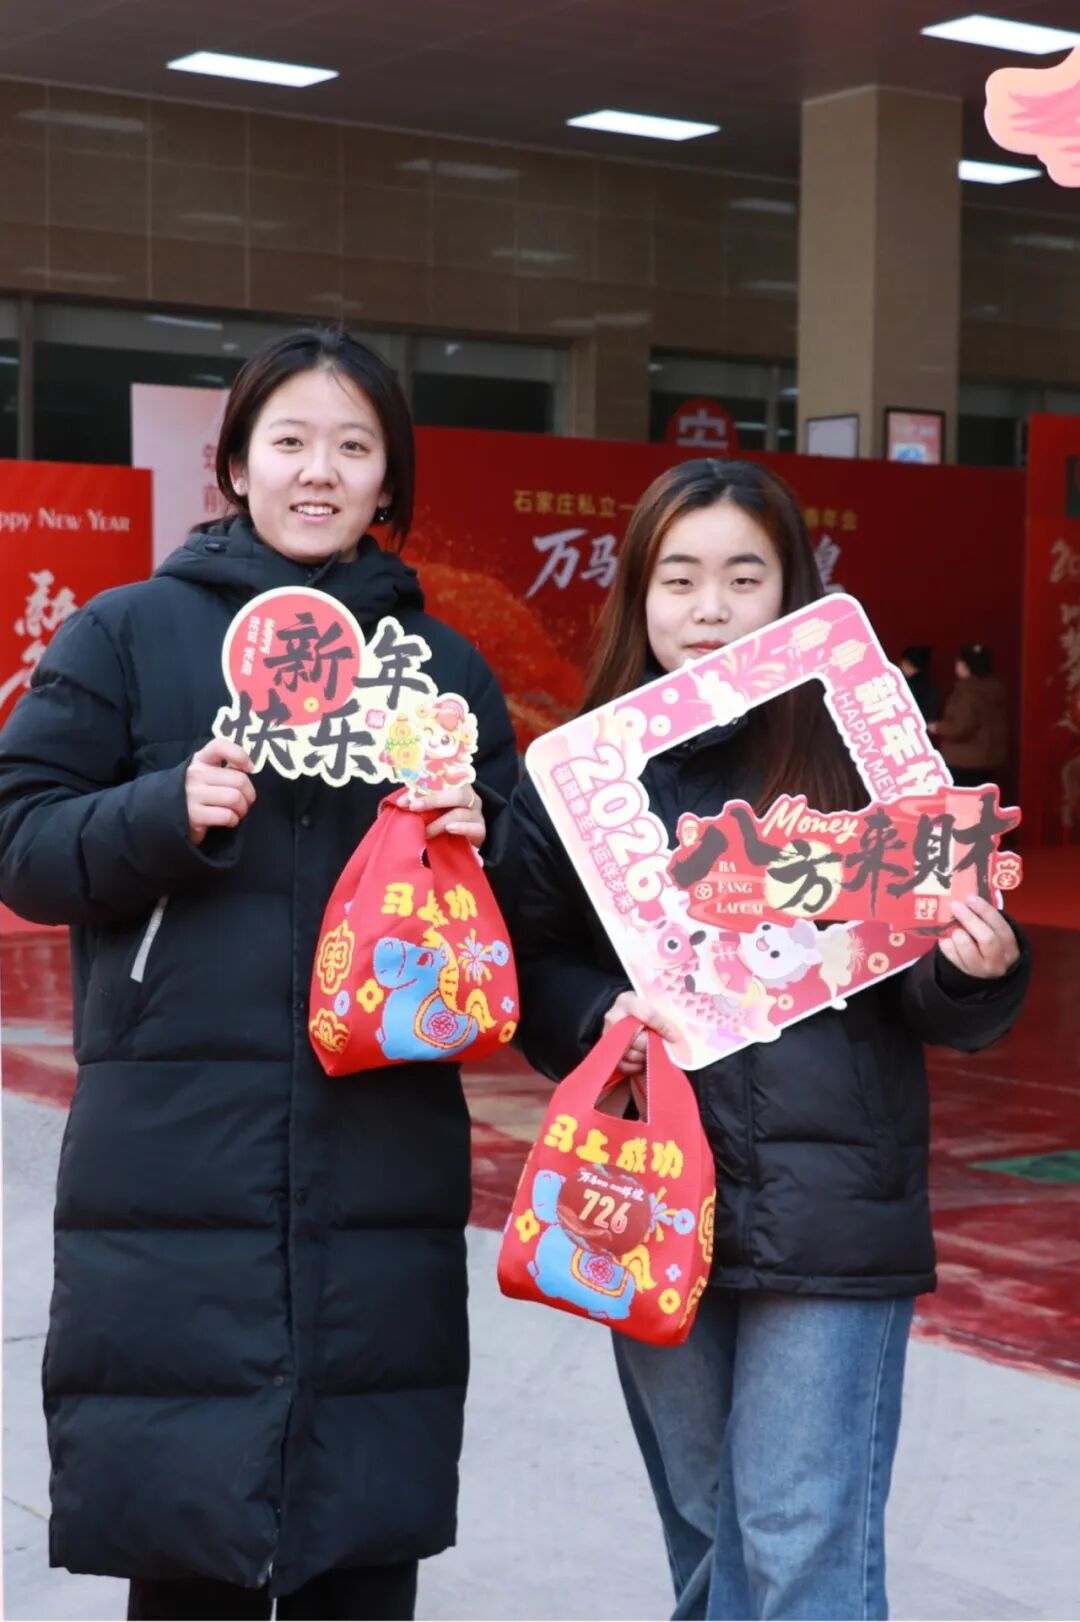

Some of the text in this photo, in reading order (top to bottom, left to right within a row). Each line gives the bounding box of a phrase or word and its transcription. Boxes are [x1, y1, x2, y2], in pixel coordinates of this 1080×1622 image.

[263, 611, 430, 711] 新年
[220, 688, 378, 780] 快乐
[567, 743, 674, 903] 2026
[761, 800, 859, 845] Money
[717, 880, 753, 894] FANG
[718, 860, 737, 873] BA
[544, 1114, 684, 1179] 马上成功
[578, 1188, 632, 1235] 726
